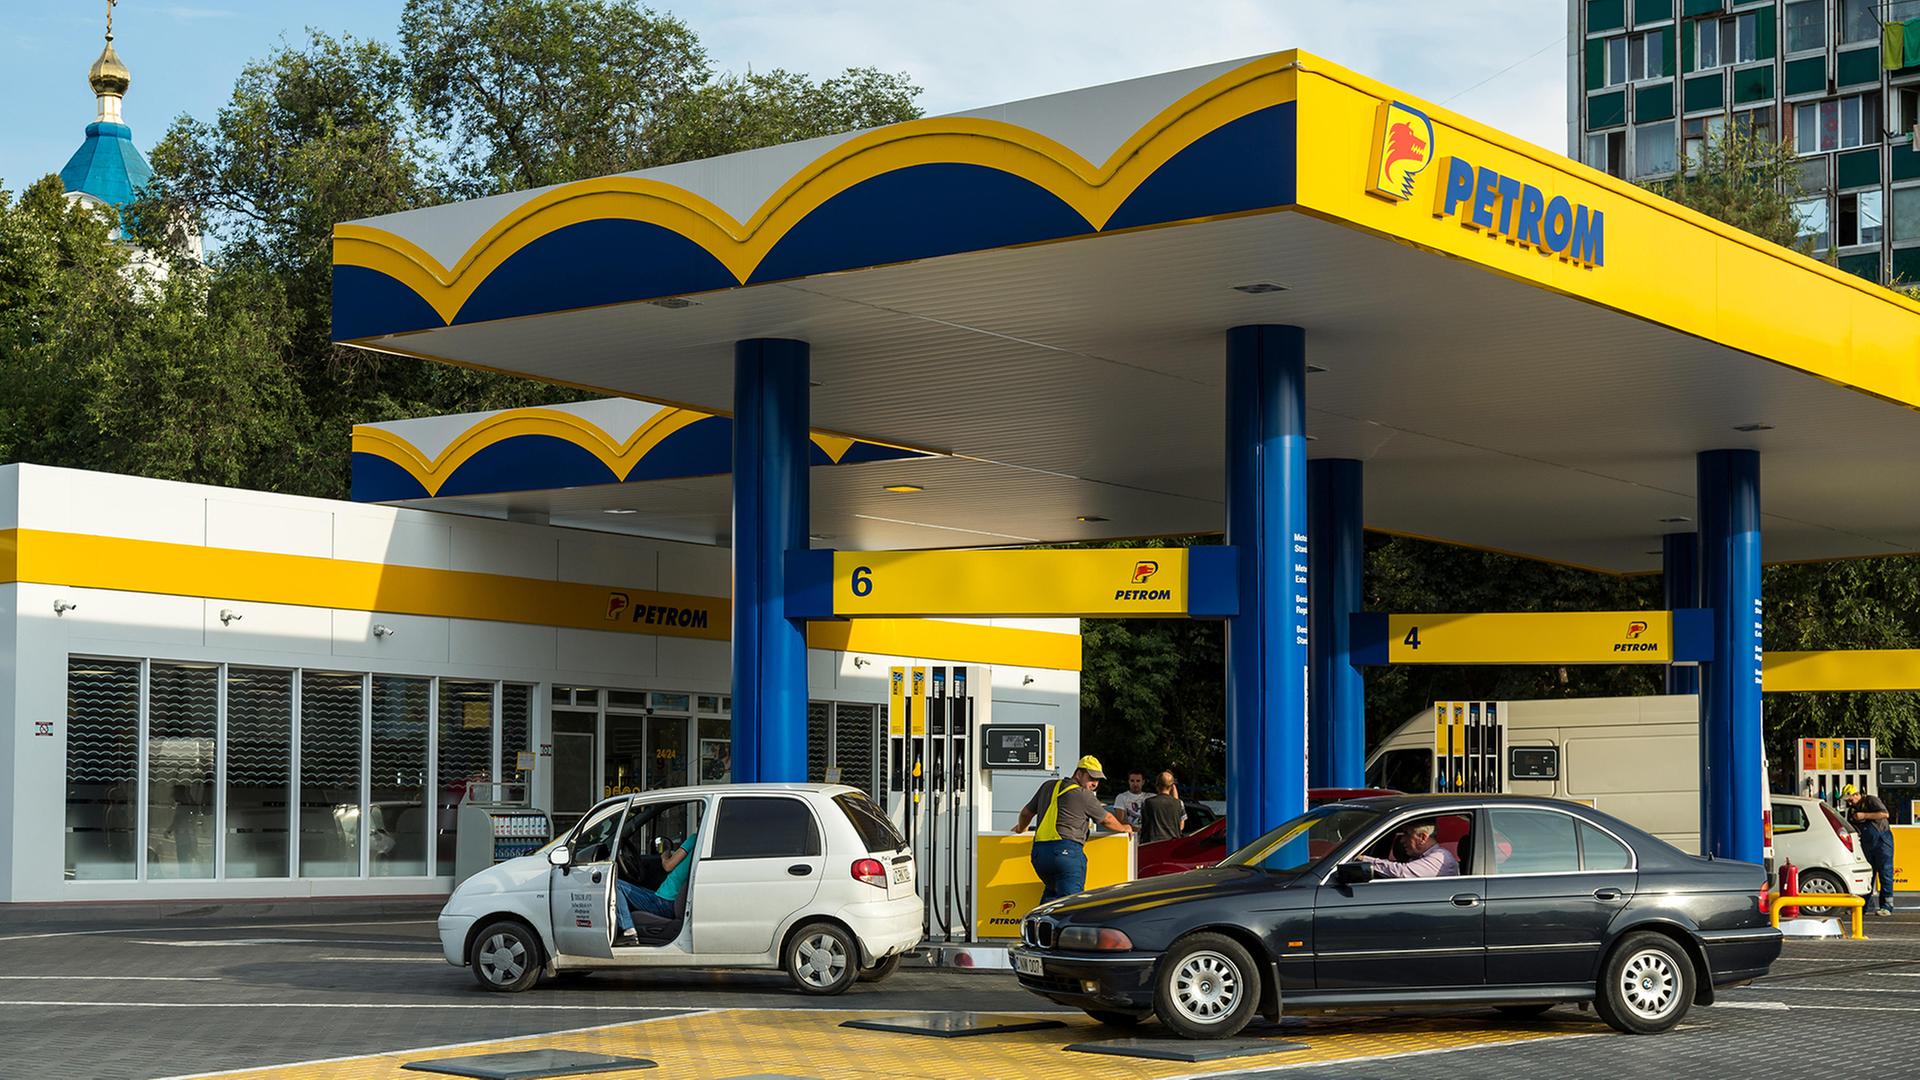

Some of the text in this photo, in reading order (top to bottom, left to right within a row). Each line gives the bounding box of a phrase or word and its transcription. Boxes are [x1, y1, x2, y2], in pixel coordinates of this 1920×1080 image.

[1444, 156, 1604, 267] PETROM
[852, 566, 873, 597] 6
[1115, 590, 1171, 600] PETROM
[632, 604, 708, 628] PETROM
[1404, 626, 1421, 650] 4
[1613, 643, 1658, 652] PETROM
[656, 750, 676, 759] 24/24
